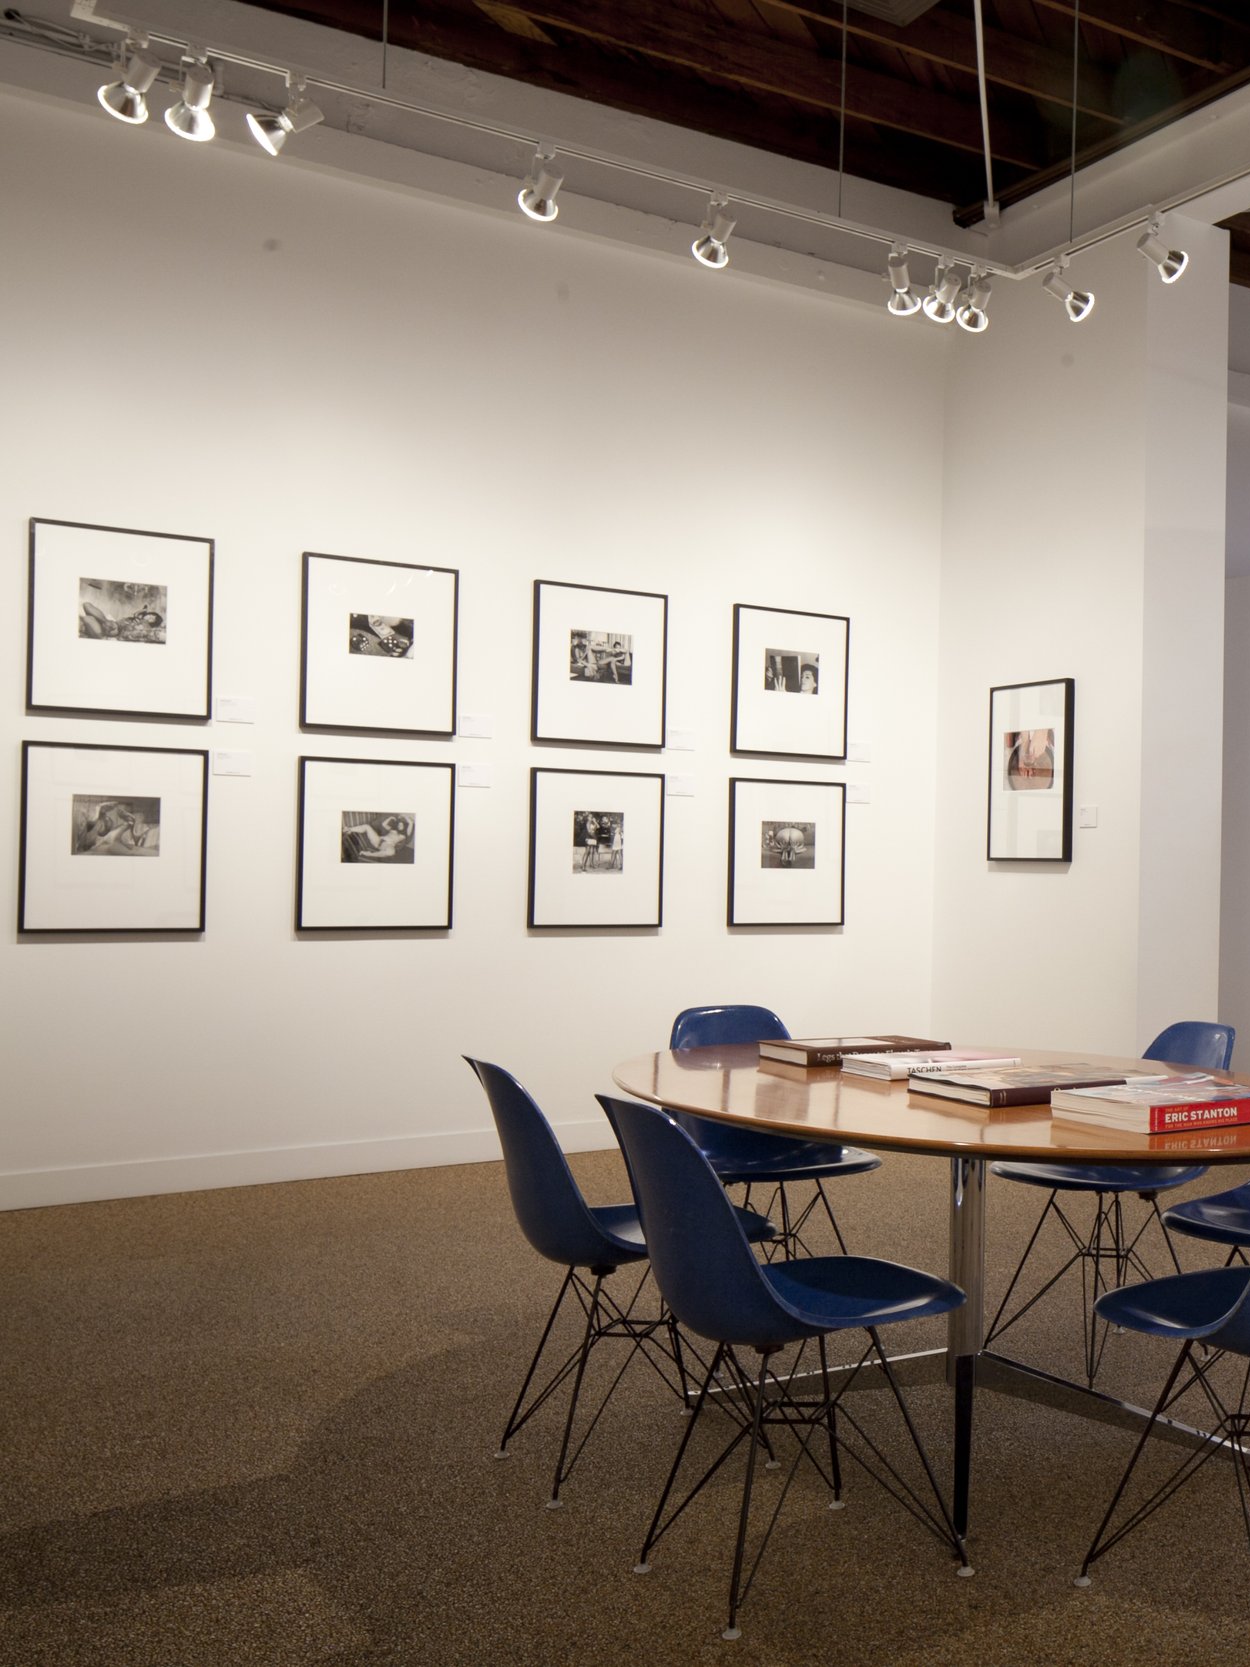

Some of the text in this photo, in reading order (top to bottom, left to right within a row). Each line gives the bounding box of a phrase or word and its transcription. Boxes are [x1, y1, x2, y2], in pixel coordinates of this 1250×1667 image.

[907, 1066, 942, 1074] TASCHEN
[1165, 1112, 1188, 1123] ERIC
[1190, 1107, 1237, 1121] STANTON
